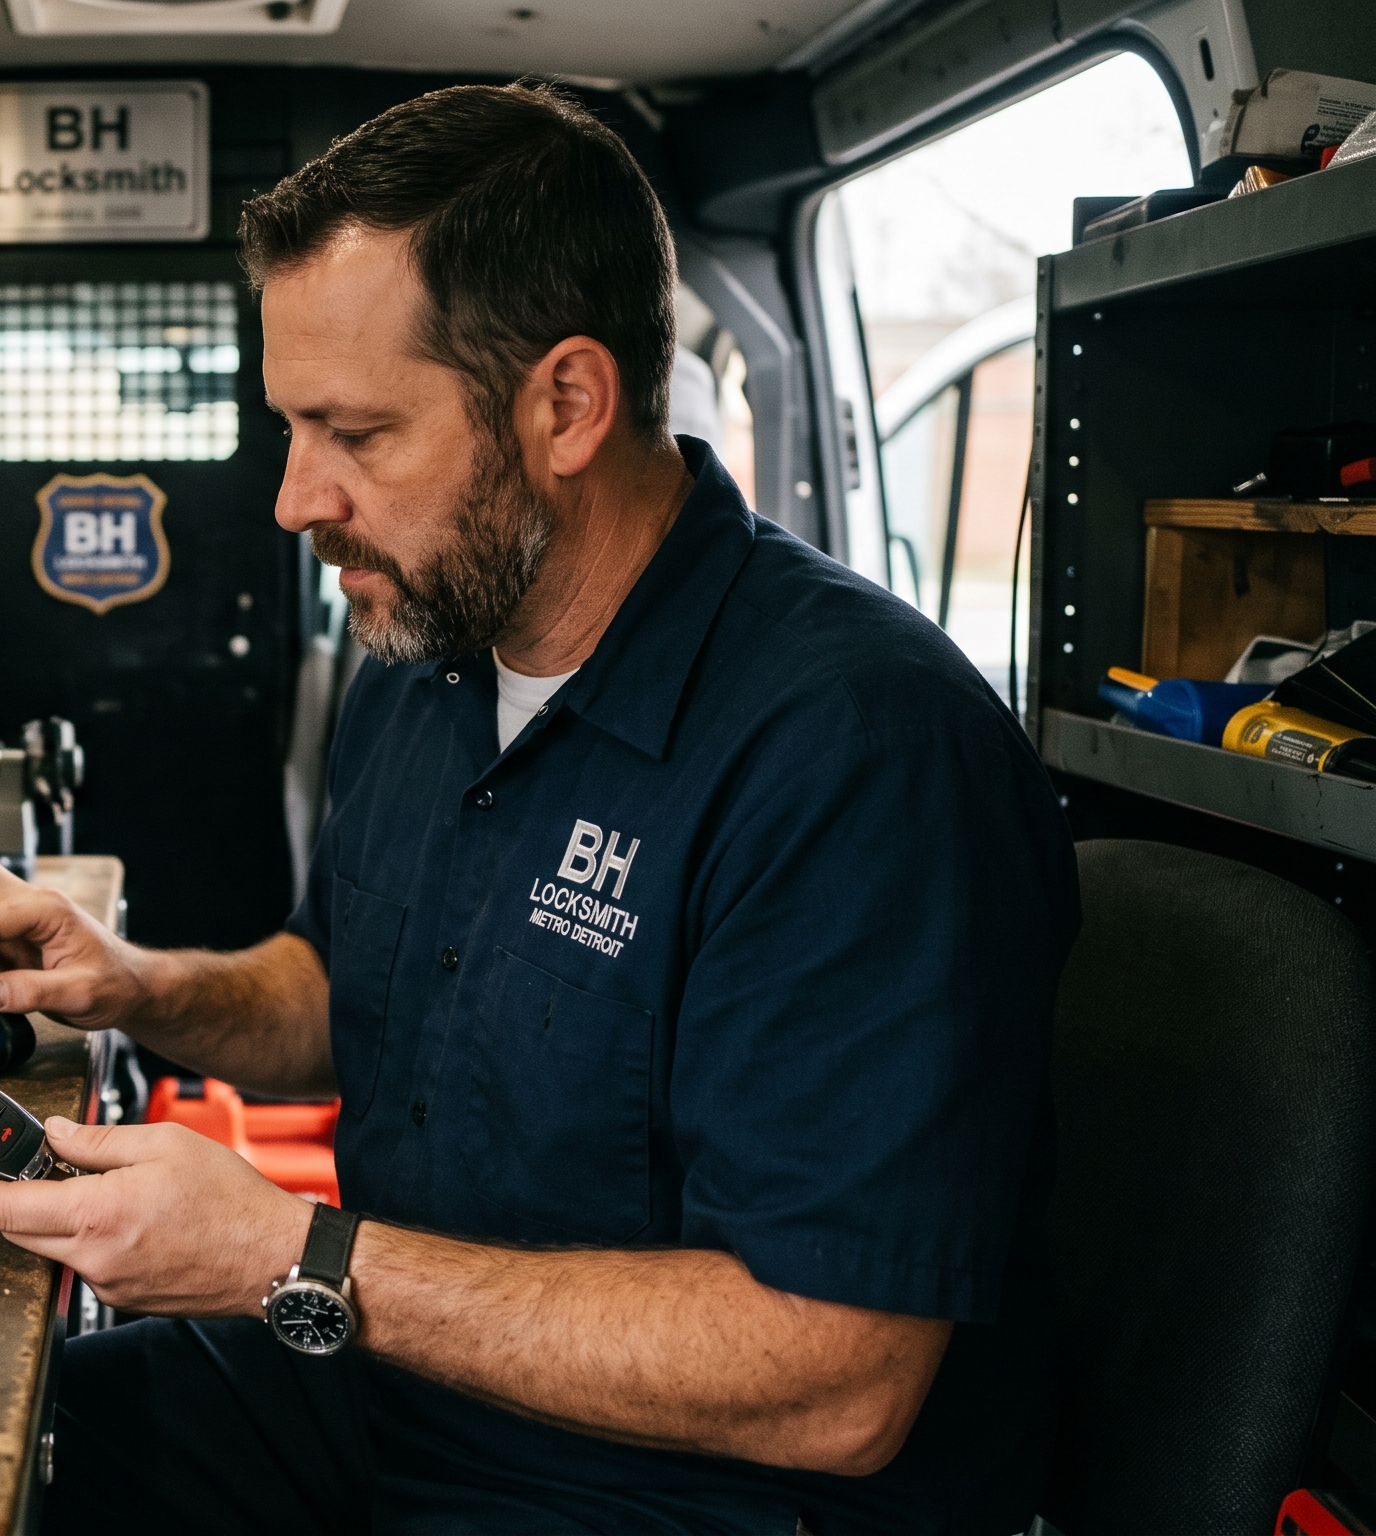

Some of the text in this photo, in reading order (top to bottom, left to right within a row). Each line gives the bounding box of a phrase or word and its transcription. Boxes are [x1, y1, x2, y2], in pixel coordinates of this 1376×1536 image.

[47, 106, 129, 151] BH
[64, 511, 137, 554] BH
[556, 818, 641, 900] BH
[529, 877, 639, 940] LOCKSMITH
[529, 907, 625, 958] METRO DETROIT
